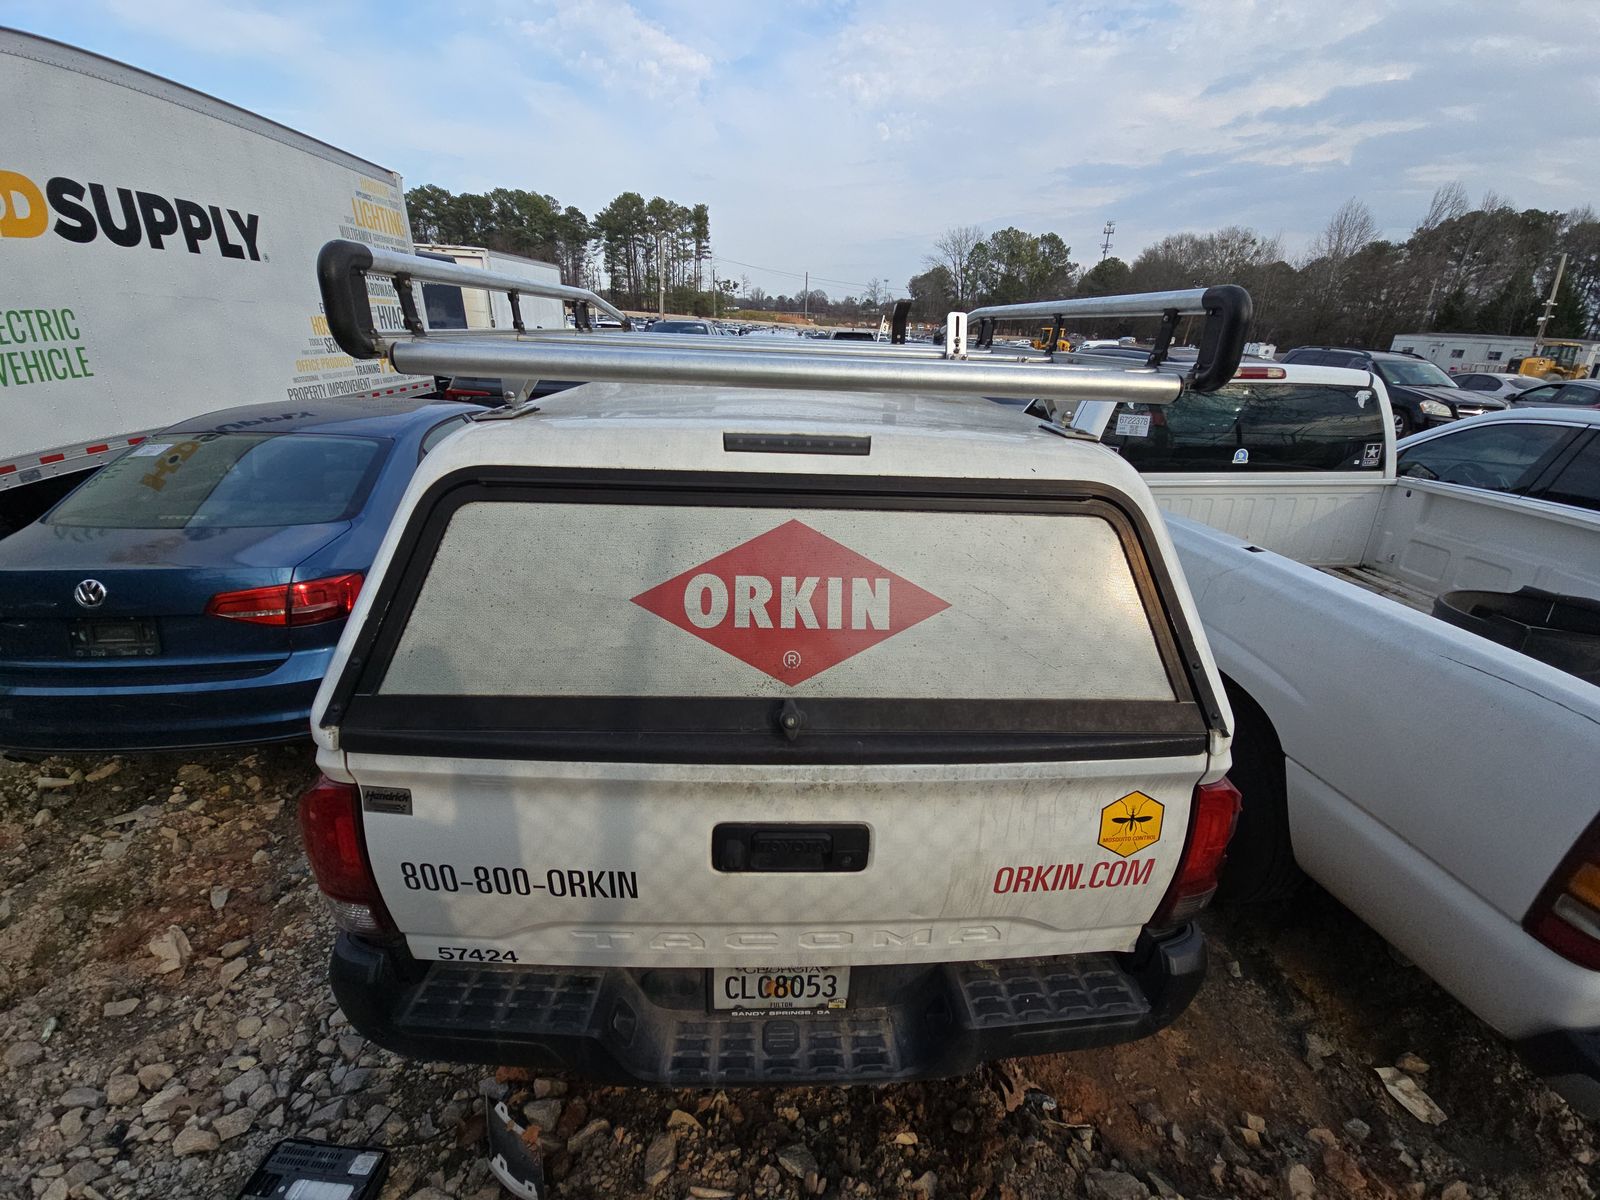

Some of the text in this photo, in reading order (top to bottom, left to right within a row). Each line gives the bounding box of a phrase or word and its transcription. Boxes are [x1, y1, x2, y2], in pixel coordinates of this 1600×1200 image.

[352, 197, 405, 238] LIGHTING
[366, 282, 397, 298] ARDWARE
[377, 305, 405, 330] HVAC
[0, 347, 94, 387] VEHICLE
[296, 360, 320, 372] OFFICE
[321, 356, 352, 368] PRODUCTS
[355, 364, 380, 376] TRAINING
[287, 385, 327, 400] PROPERTY
[328, 378, 372, 396] IMPROVEMENT
[683, 573, 891, 631] ORKIN
[400, 861, 639, 899] 800-800-ORKIN
[993, 858, 1156, 894] ORKIN.COM
[571, 925, 1001, 949] TACOMA
[438, 947, 519, 964] 57424
[725, 974, 837, 1000] CLC8053
